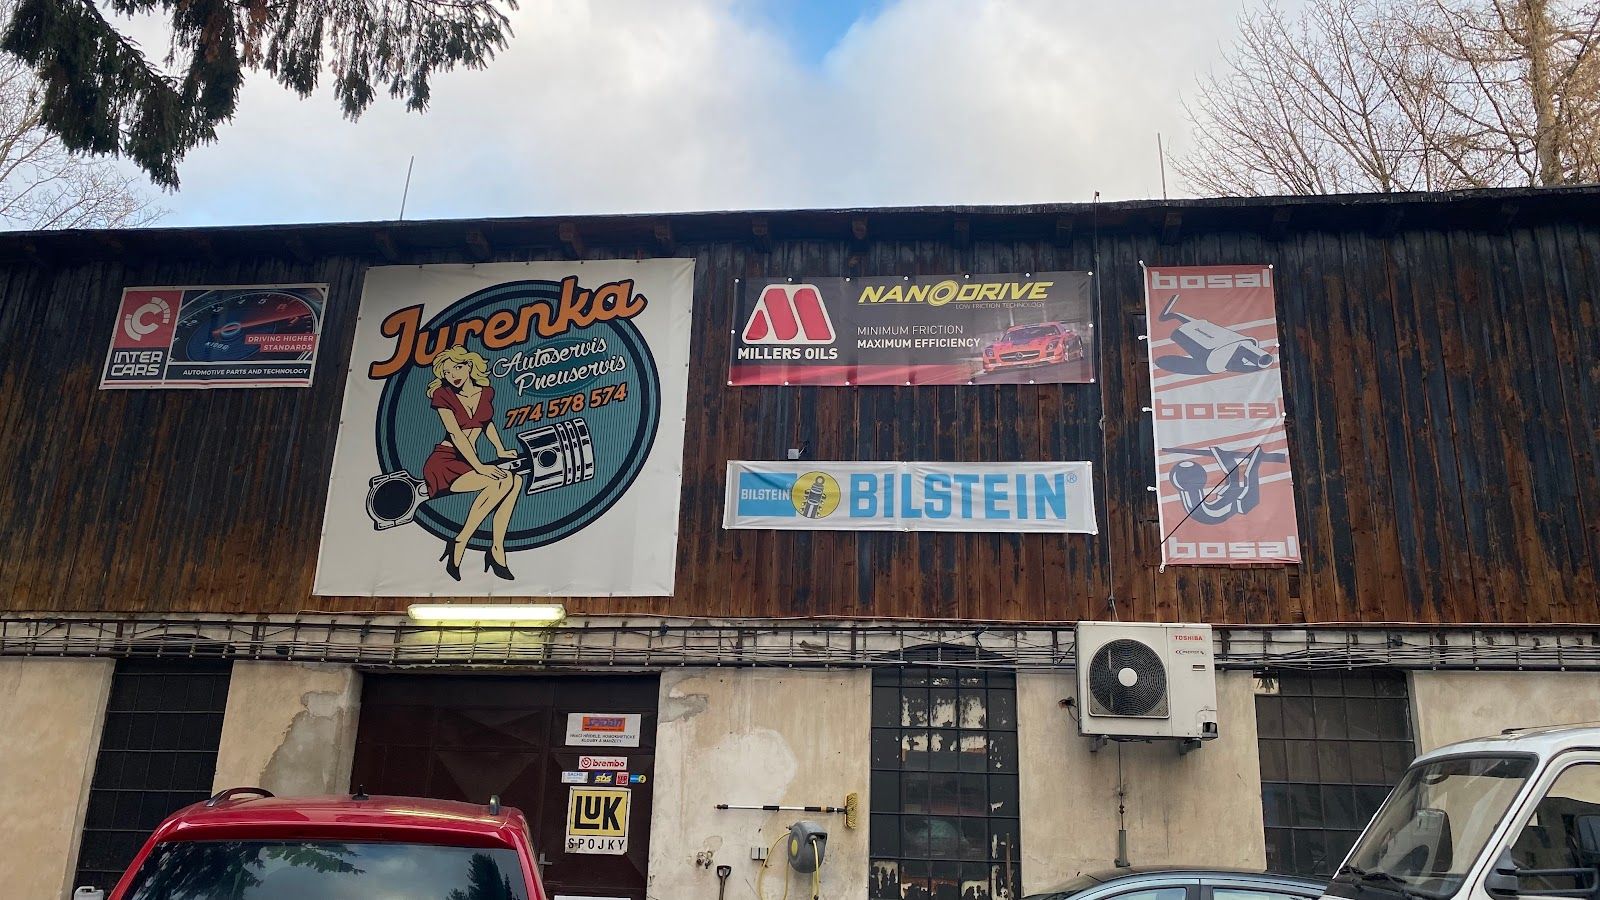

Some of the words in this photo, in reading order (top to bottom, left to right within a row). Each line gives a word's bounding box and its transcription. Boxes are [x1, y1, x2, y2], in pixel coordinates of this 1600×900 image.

[1151, 269, 1271, 289] bosal
[858, 280, 1054, 306] NANODRIVE
[368, 275, 649, 380] Jurenka
[857, 326, 909, 336] MINIMUM
[912, 325, 964, 335] FRICTION
[737, 347, 801, 360] MILLERS
[804, 347, 838, 360] OILS
[857, 339, 912, 349] MAXIMUM
[914, 338, 981, 348] EFFICIENCY
[113, 351, 163, 363] INTER
[493, 337, 607, 378] Autoservis
[111, 364, 160, 376] CARS
[514, 355, 627, 396] Pneuservis
[504, 403, 543, 430] 774
[546, 393, 585, 418] 578
[590, 383, 628, 409] 574
[1156, 397, 1284, 420] bosal
[741, 488, 790, 501] BILSTEIN
[849, 473, 1067, 520] BILSTEIN
[1168, 535, 1298, 559] bosal
[592, 759, 625, 767] brembo
[568, 838, 624, 850] SPOJKY
